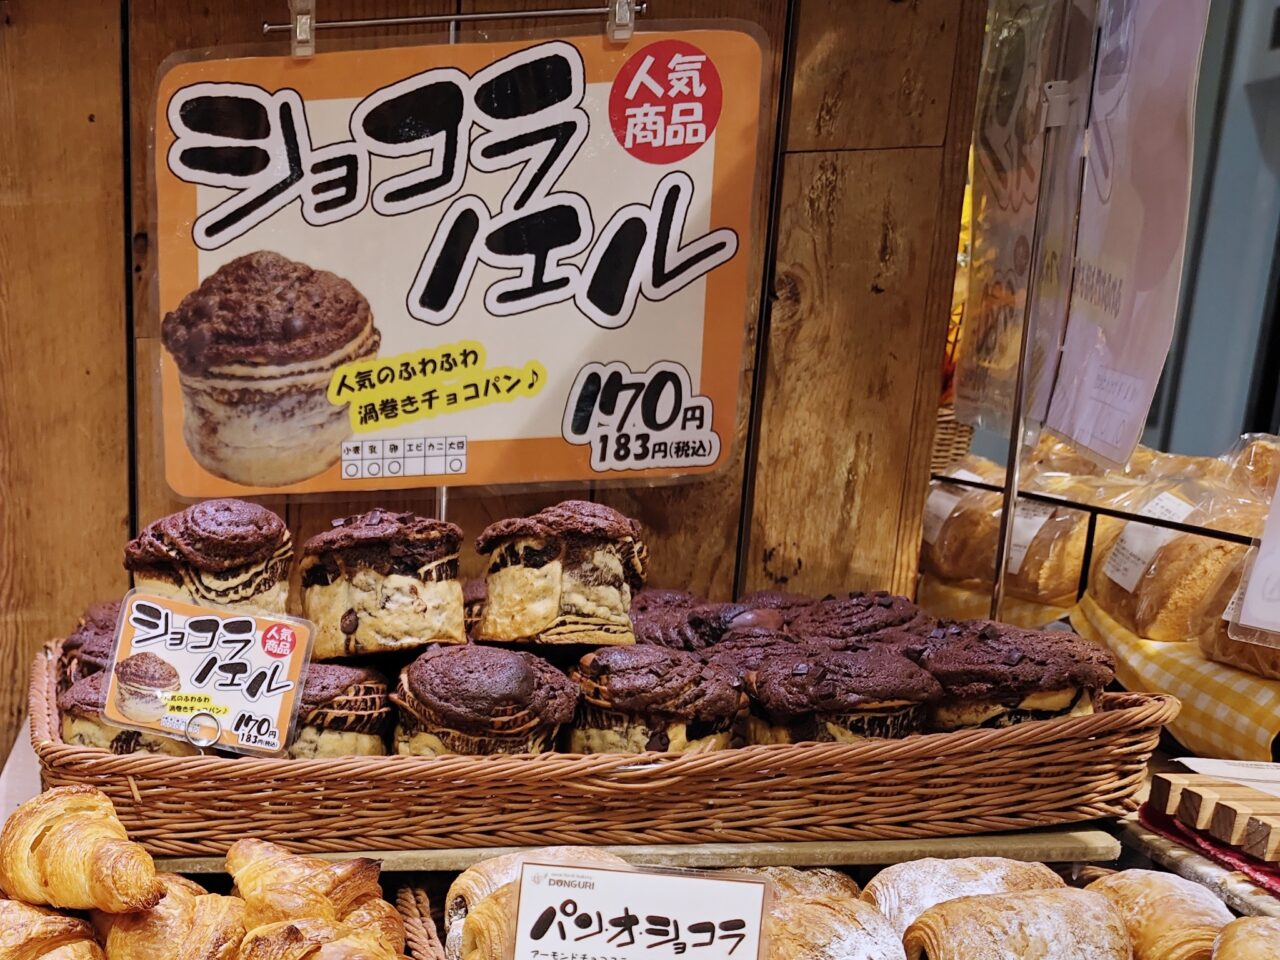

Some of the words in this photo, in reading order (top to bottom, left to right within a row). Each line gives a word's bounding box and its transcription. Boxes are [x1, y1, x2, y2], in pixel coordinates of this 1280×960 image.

[625, 53, 706, 99] 人気
[174, 47, 582, 243] ショコラ
[625, 103, 706, 149] 商品
[414, 178, 733, 321] ノエル
[337, 349, 478, 396] 人気のふわふわ
[571, 370, 705, 435] 170円
[599, 433, 712, 463] 183円(税込)
[130, 601, 255, 662] ショコラ
[264, 642, 291, 655] 商品
[267, 626, 293, 641] 人気
[192, 654, 292, 699] ノエル
[234, 713, 277, 738] 170円
[548, 878, 595, 890] DONGURI
